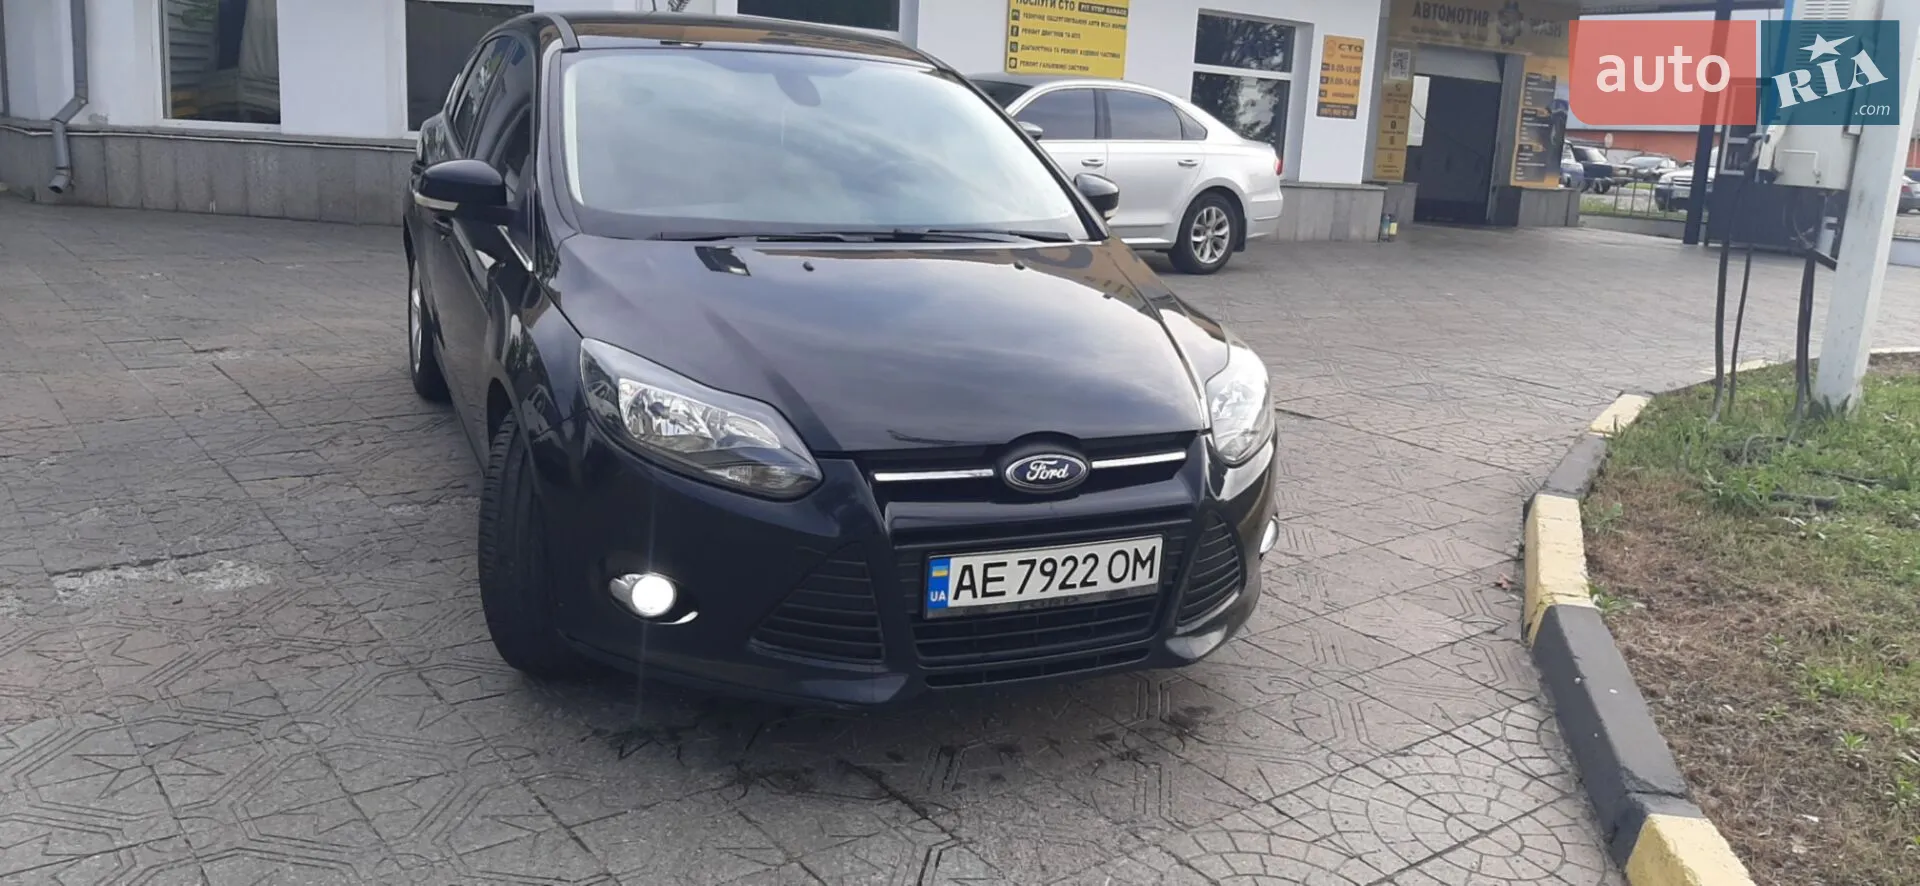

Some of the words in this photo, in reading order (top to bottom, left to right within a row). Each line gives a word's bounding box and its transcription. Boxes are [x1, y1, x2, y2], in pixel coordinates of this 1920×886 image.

[1026, 460, 1069, 481] Ford
[953, 561, 1008, 600] AE
[1017, 553, 1099, 595] 7922
[1107, 545, 1156, 584] OM
[930, 590, 946, 602] UA
